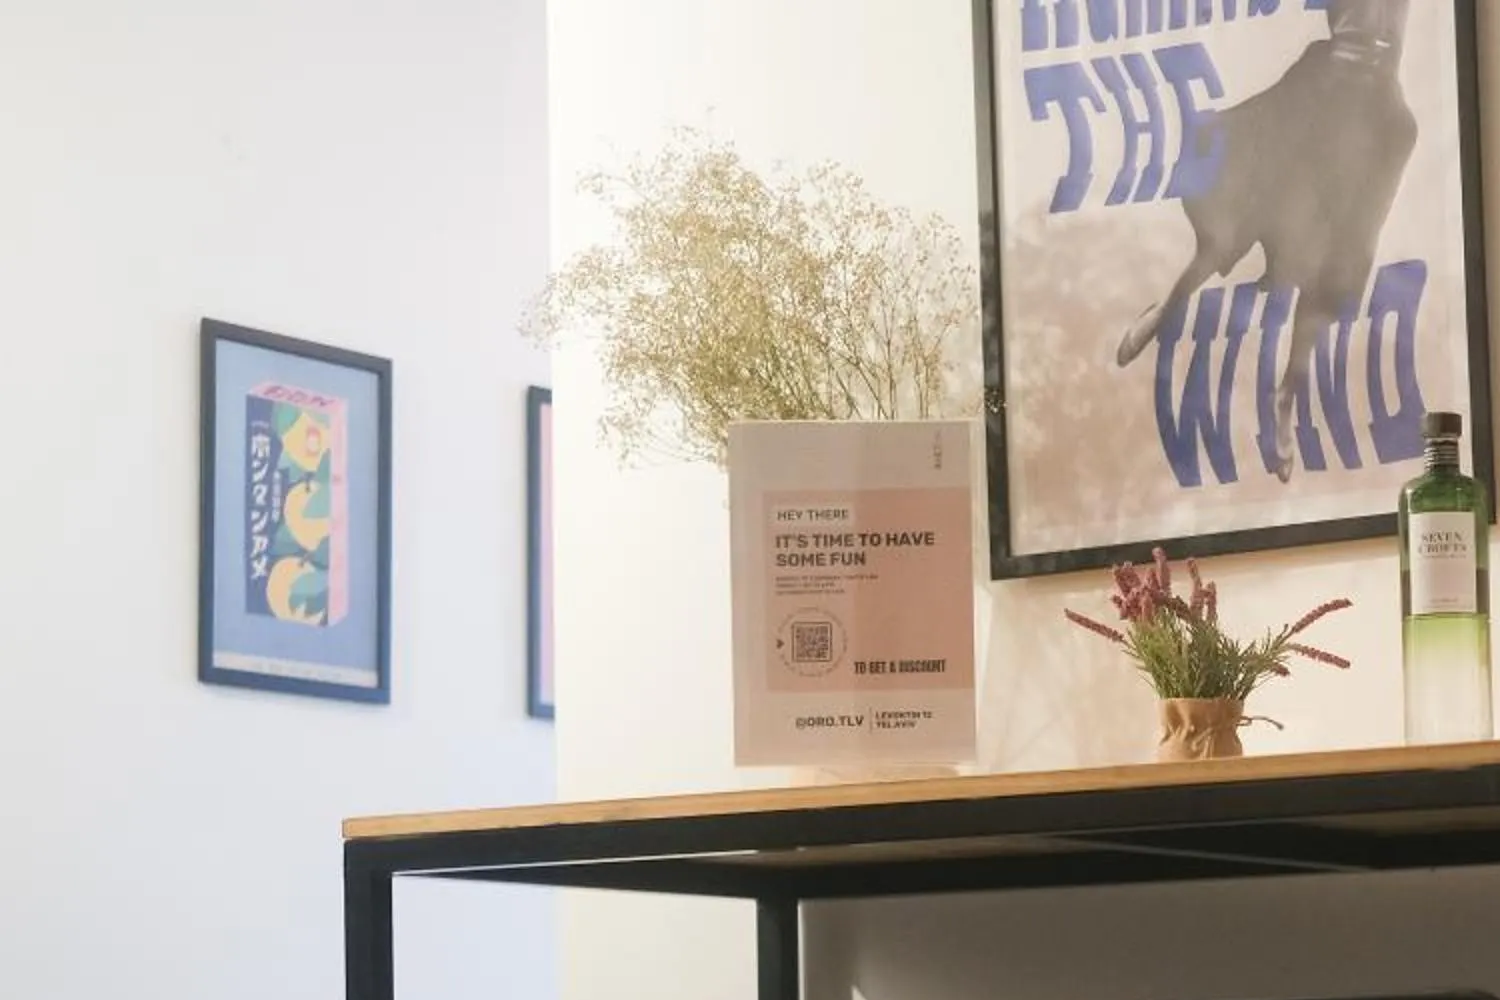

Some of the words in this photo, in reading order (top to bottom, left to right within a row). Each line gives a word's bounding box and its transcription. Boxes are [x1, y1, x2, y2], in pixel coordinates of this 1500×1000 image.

[1023, 42, 1226, 213] THE
[776, 509, 803, 521] HEY
[807, 508, 849, 521] THERE
[775, 534, 809, 549] IT'S
[812, 533, 855, 548] TIME
[859, 533, 882, 547] TO
[885, 531, 935, 547] HAVE
[775, 553, 827, 567] SOME
[830, 551, 867, 567] FUN
[854, 661, 866, 674] TO
[898, 659, 946, 673] DISCOUNT
